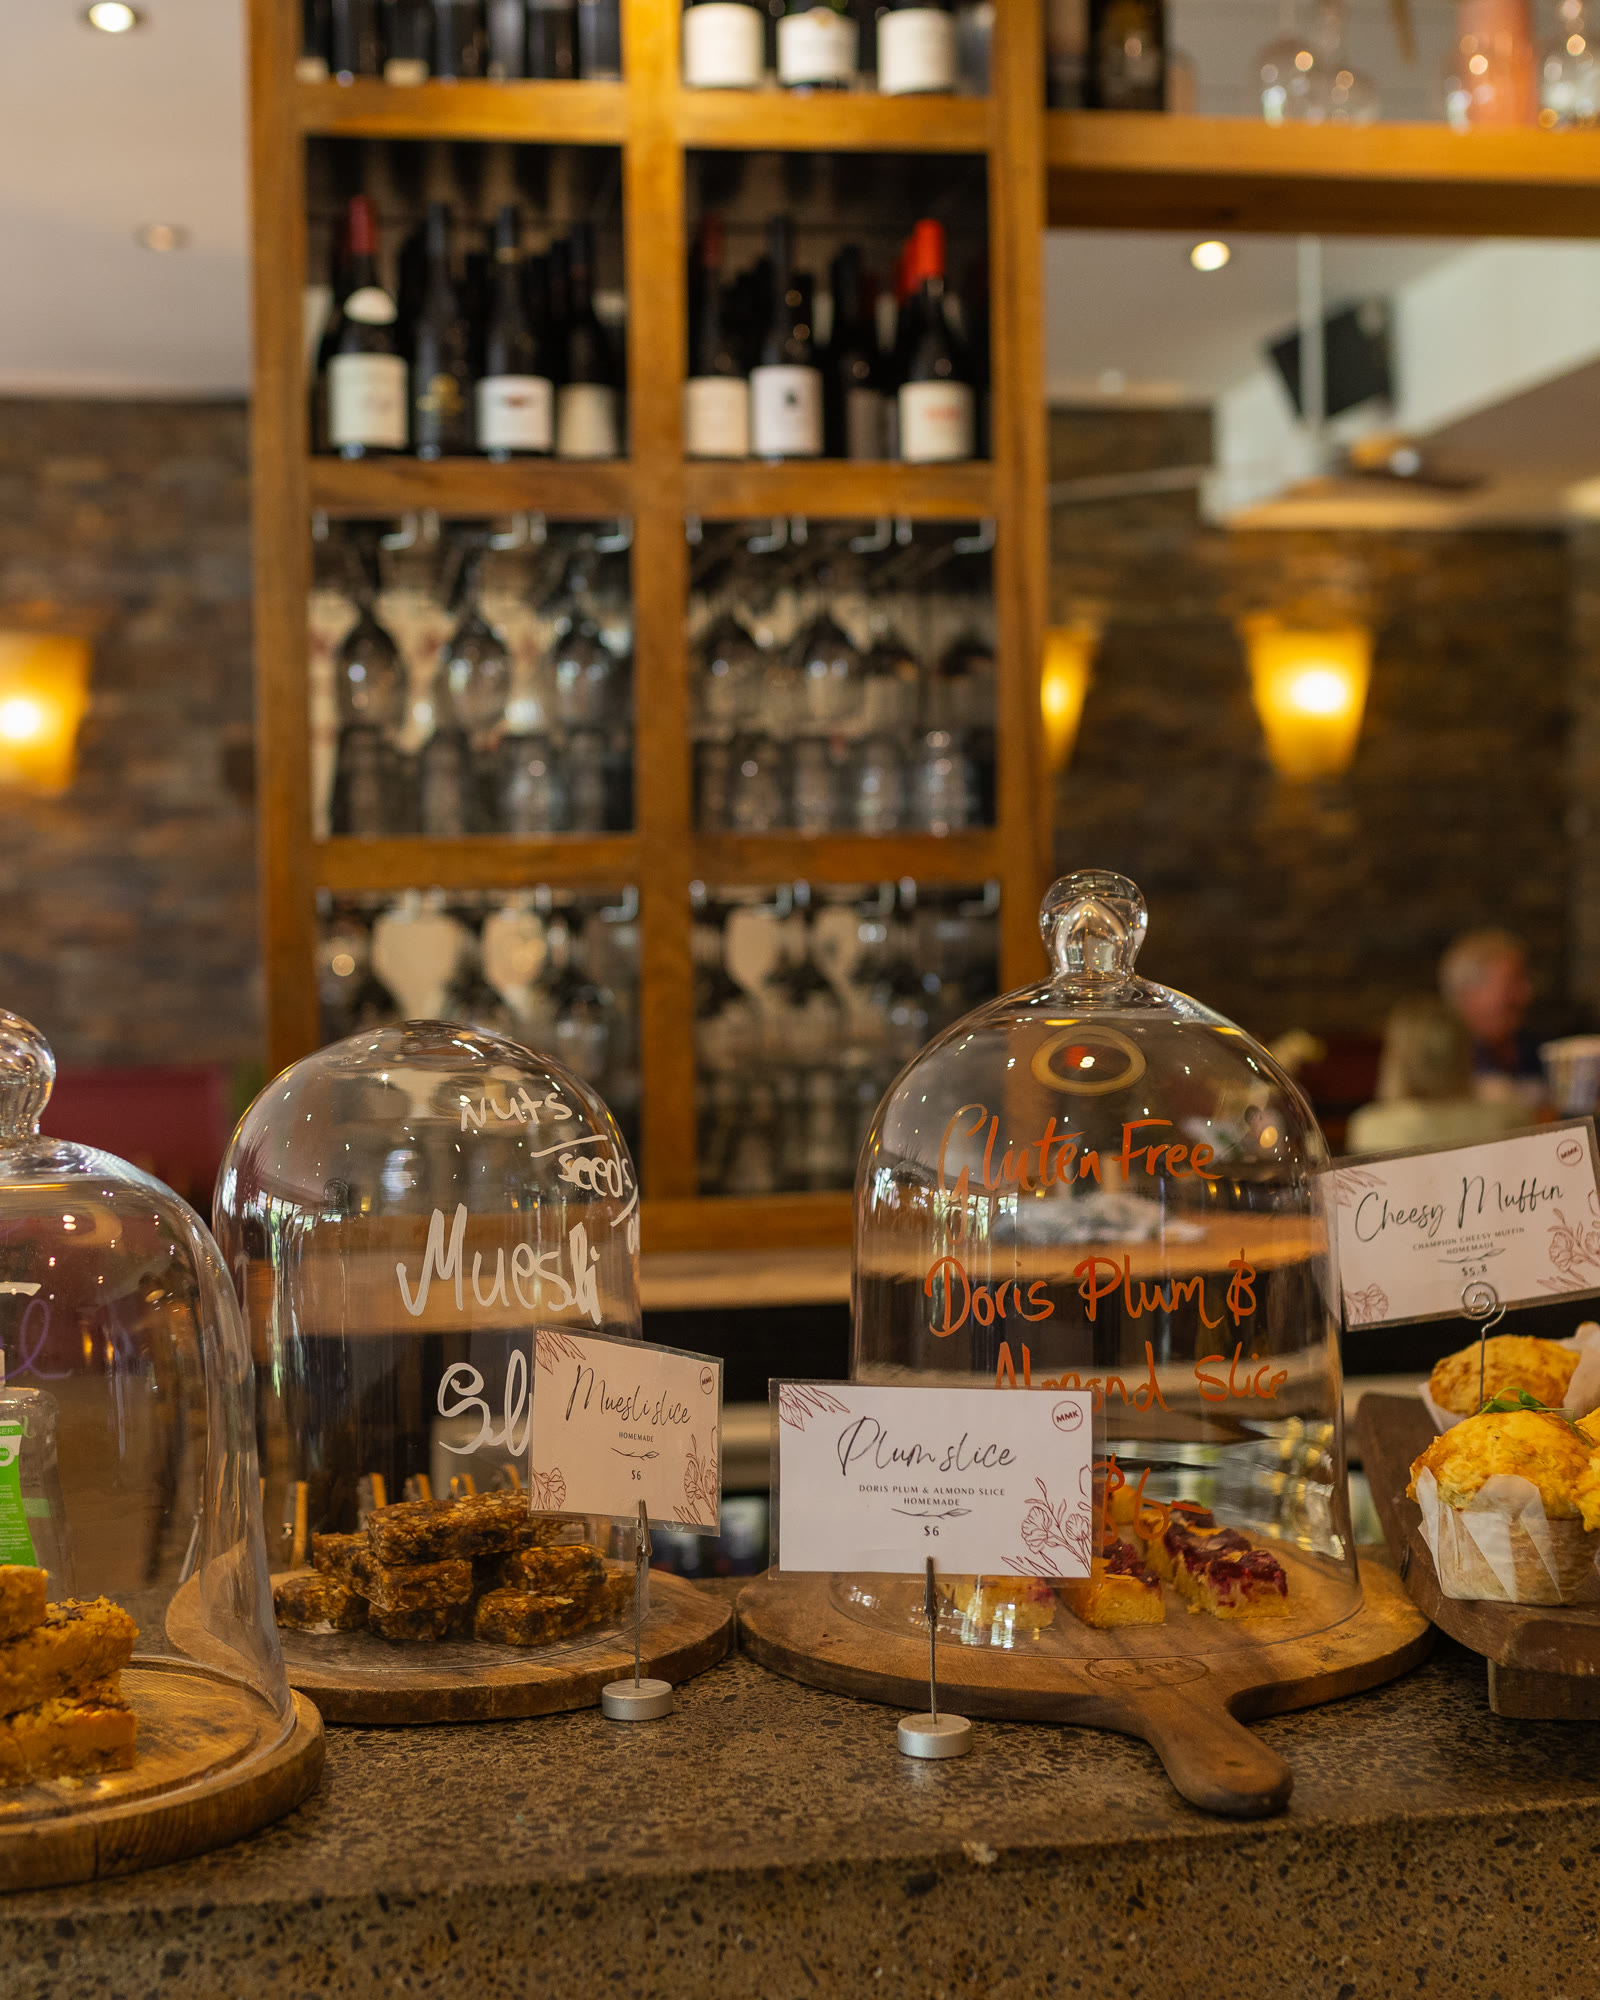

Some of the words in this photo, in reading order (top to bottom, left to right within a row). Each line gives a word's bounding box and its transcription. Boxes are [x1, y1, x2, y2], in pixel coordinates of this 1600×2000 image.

[937, 1103, 1101, 1245] Gluten
[1111, 1118, 1225, 1183] Free
[1355, 1191, 1447, 1242] Cheesy
[1457, 1176, 1563, 1229] Muffin
[1412, 1238, 1457, 1251] CHAMPION
[1460, 1232, 1491, 1243] CHEESY
[1494, 1226, 1525, 1237] MUFFIN
[1446, 1242, 1494, 1255] HOMEMADE
[396, 1202, 602, 1326] Muesli
[924, 1255, 1055, 1338] Doris
[1073, 1253, 1225, 1329] Plum
[1056, 1409, 1079, 1423] MMK
[618, 1431, 654, 1443] HOMEMADE
[631, 1469, 642, 1481] $6
[859, 1484, 889, 1493] DORIS
[892, 1485, 919, 1494] PLUM
[922, 1486, 929, 1494] &
[933, 1487, 975, 1496] ALMOND
[978, 1488, 1006, 1497] SLICE
[903, 1497, 961, 1506] HOMEMADE
[924, 1525, 940, 1537] $6
